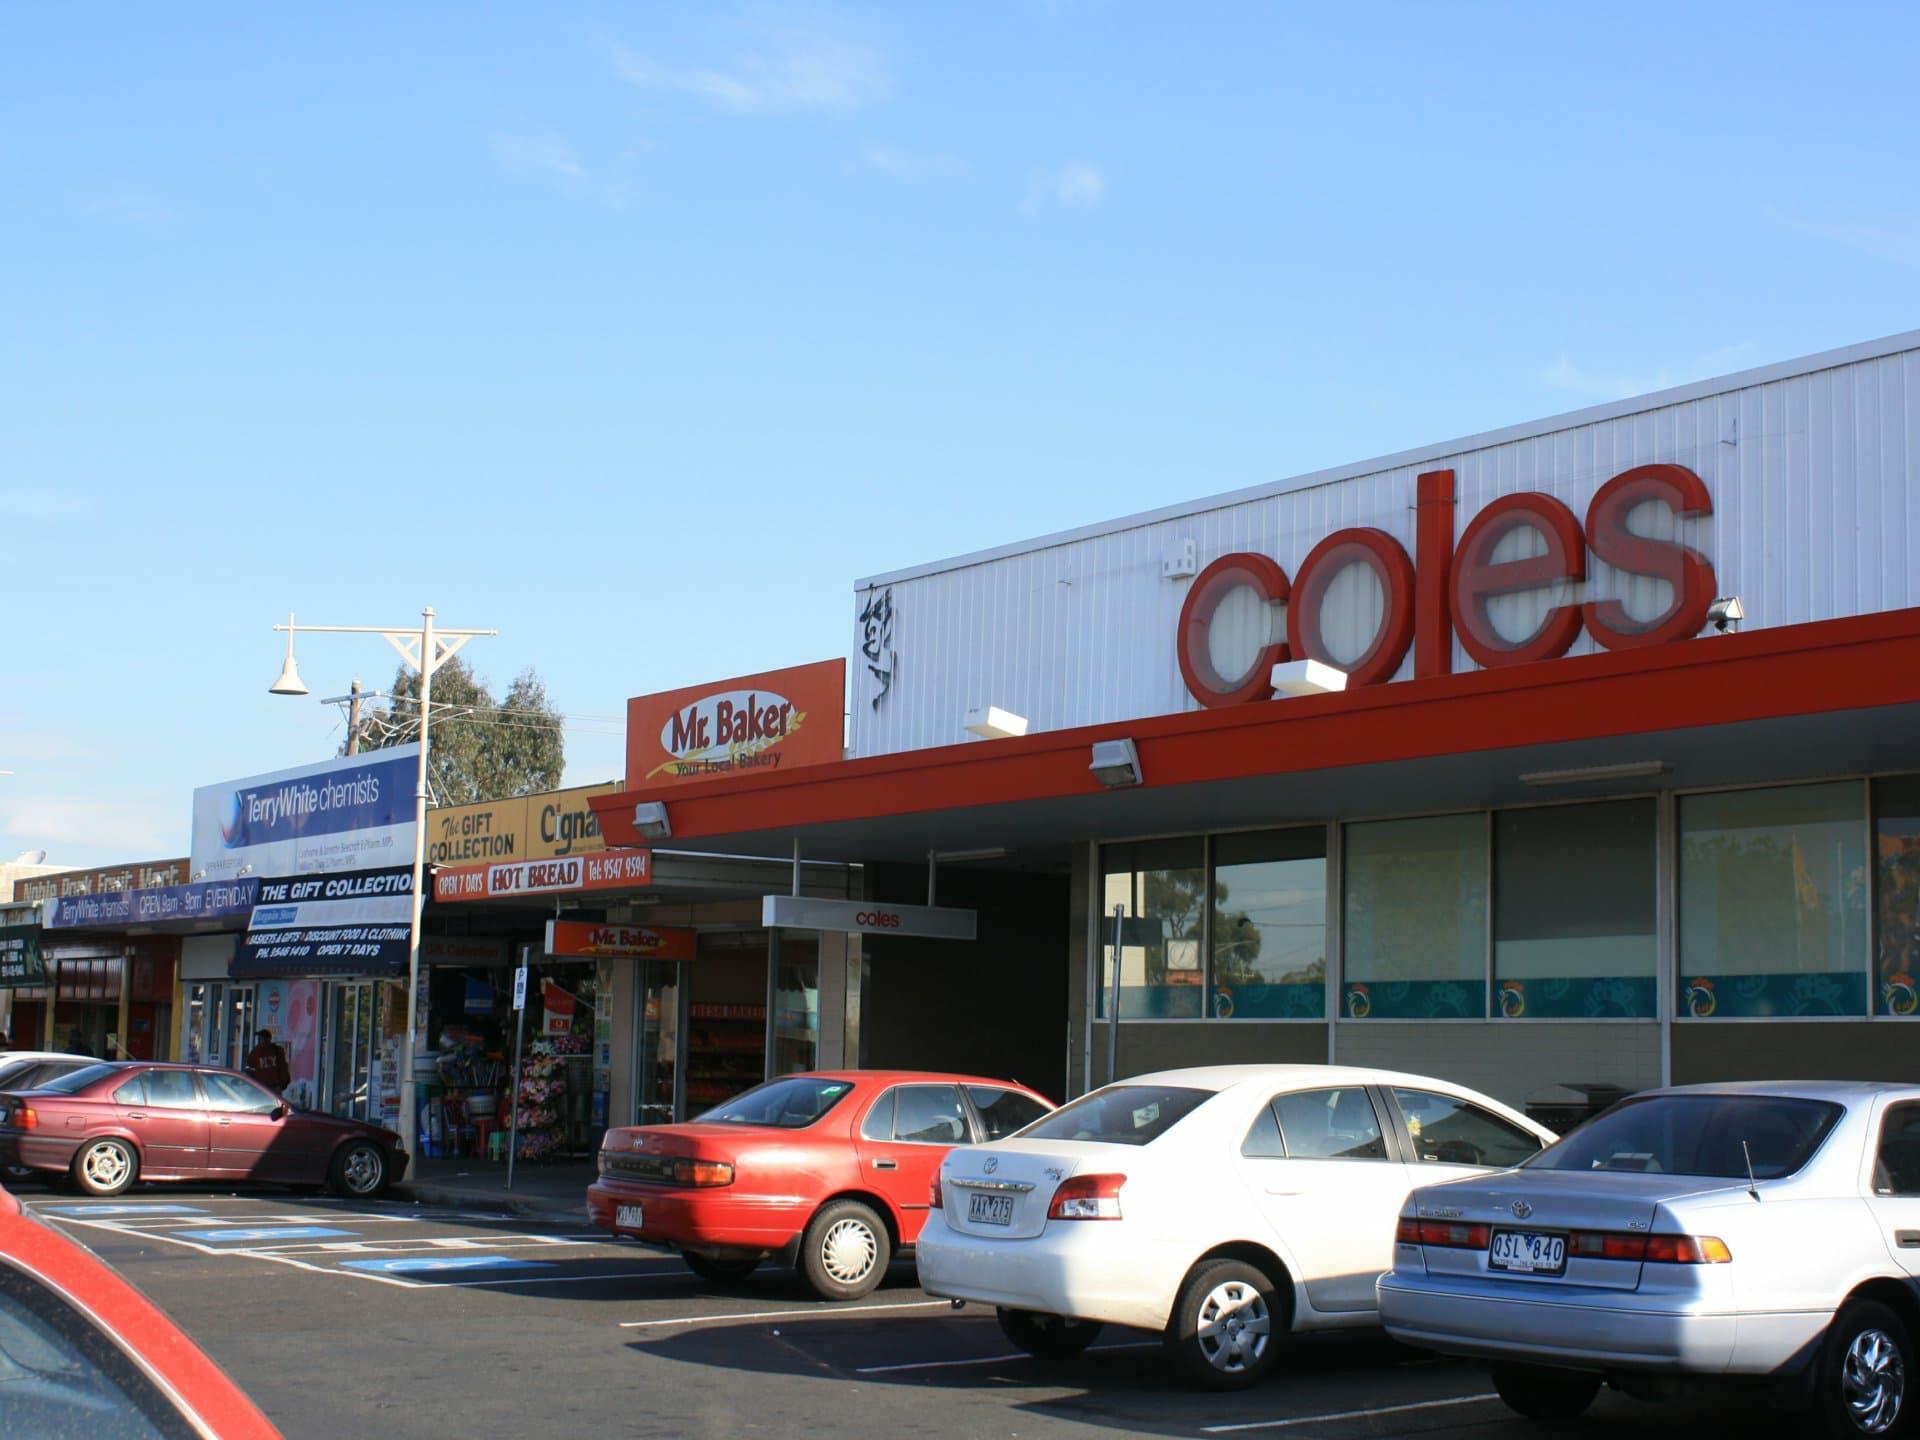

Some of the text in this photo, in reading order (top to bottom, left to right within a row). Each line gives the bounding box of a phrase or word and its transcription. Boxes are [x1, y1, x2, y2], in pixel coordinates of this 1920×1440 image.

[1177, 463, 1718, 711] coles
[671, 693, 792, 753] Mr. Baker
[676, 752, 782, 778] Your Local Bakery
[319, 773, 380, 811] chemists
[441, 812, 493, 841] The GIFT
[429, 833, 515, 862] COLLECTION
[491, 861, 579, 892] HOT BREAD
[603, 857, 623, 880] 9547
[625, 855, 646, 877] 9594
[261, 873, 416, 901] THE GIFT COLLECTIO
[439, 872, 483, 897] OPEN 7 DAYS
[139, 895, 161, 915] OPEN
[161, 894, 178, 913] 9am
[185, 891, 201, 915] 9pm
[204, 884, 255, 910] EVERYDAY
[855, 909, 900, 929] coles
[280, 931, 302, 943] GIFTS
[304, 929, 341, 942] DISCOUNT
[340, 928, 360, 940] FOOD
[367, 927, 411, 941] CLOTHING
[619, 930, 662, 947] Baker
[316, 945, 343, 956] OPEN
[343, 944, 353, 956] 7
[352, 944, 381, 957] DAYS
[992, 1197, 1011, 1219] 275
[1494, 1236, 1564, 1262] QSL 840
